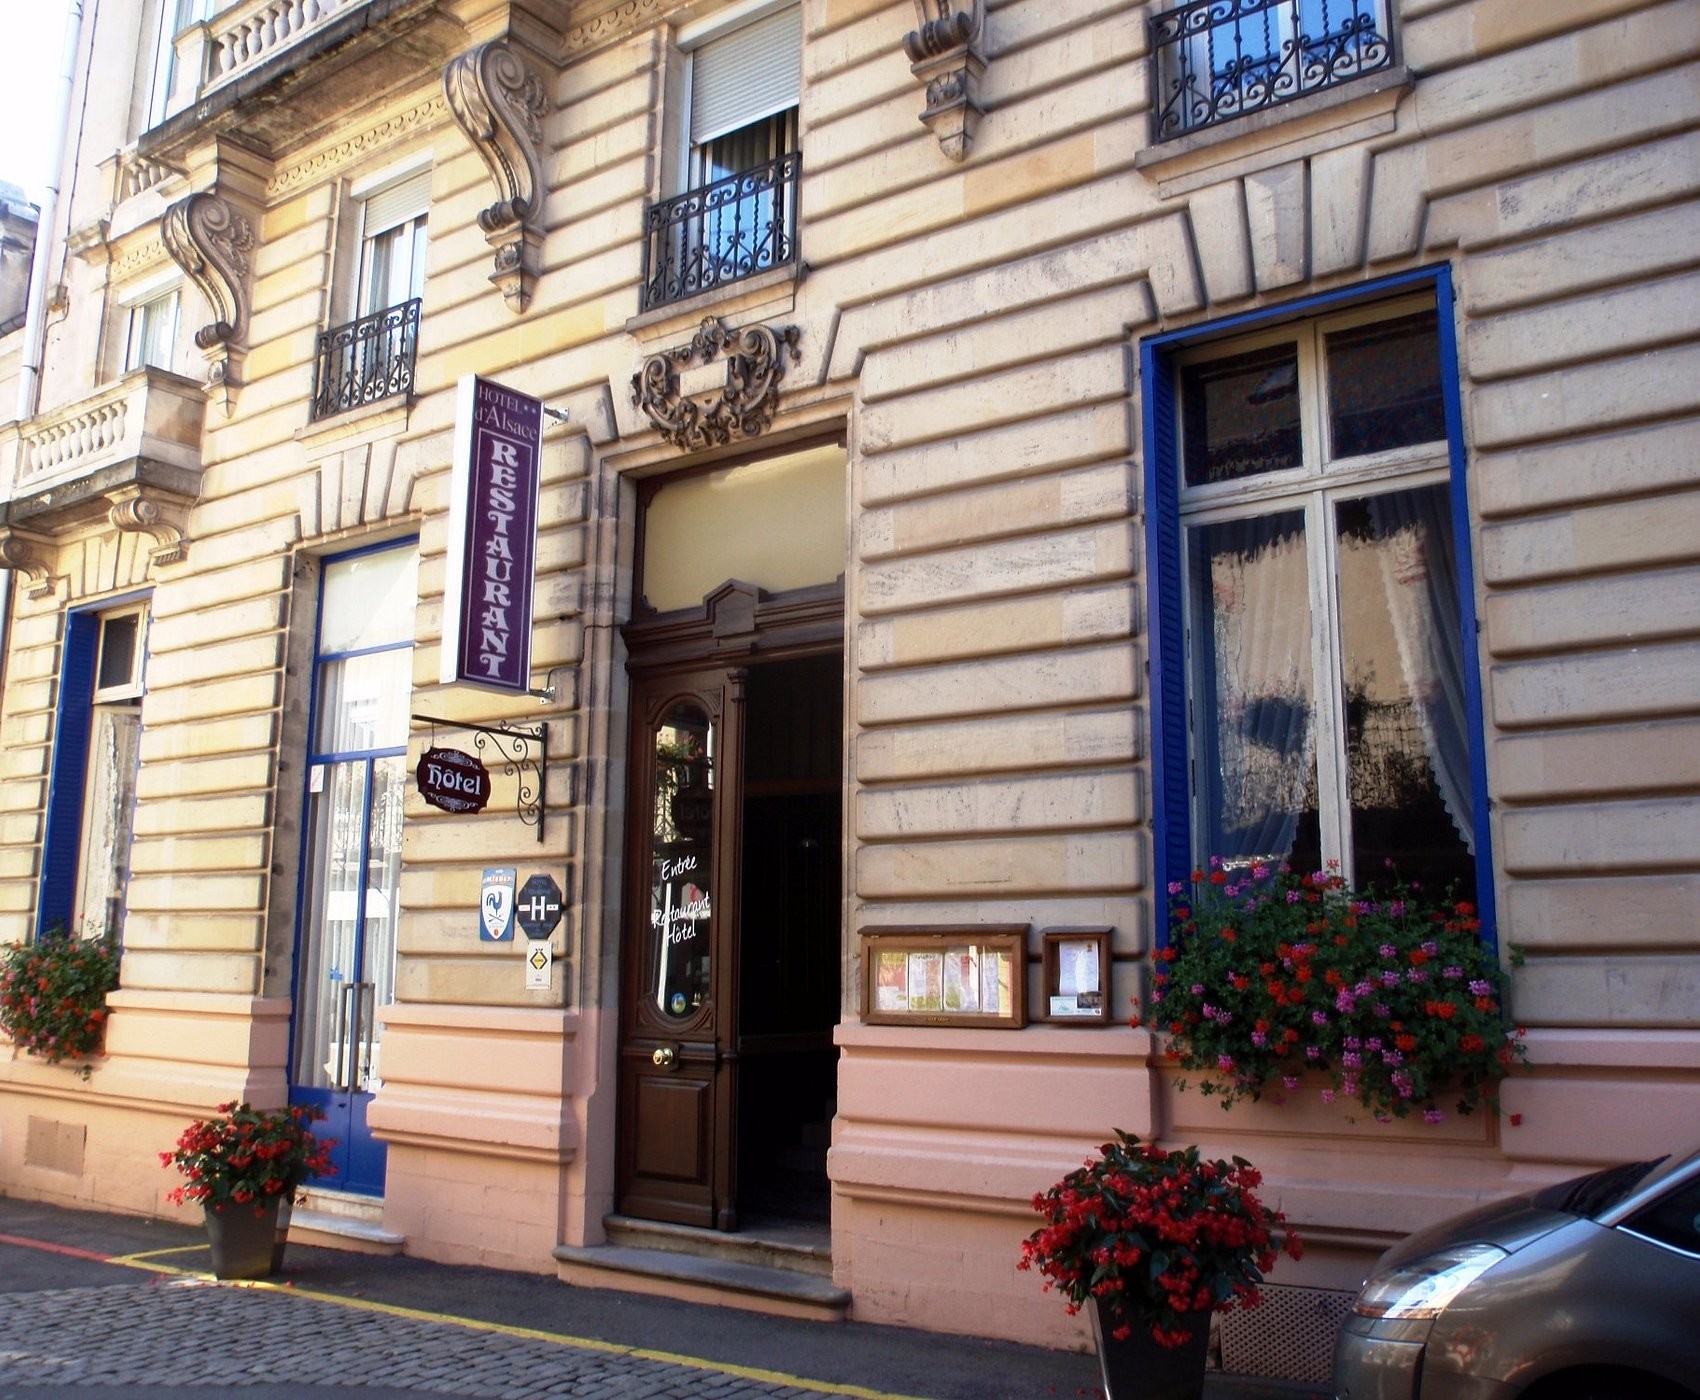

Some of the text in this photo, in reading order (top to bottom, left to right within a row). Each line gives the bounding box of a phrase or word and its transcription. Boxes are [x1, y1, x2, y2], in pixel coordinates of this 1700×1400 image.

[478, 385, 522, 414] HOTEL
[475, 406, 537, 441] d'Alsace
[480, 439, 518, 677] RESTAURANT
[531, 896, 546, 921] H
[666, 916, 696, 946] Hôtel
